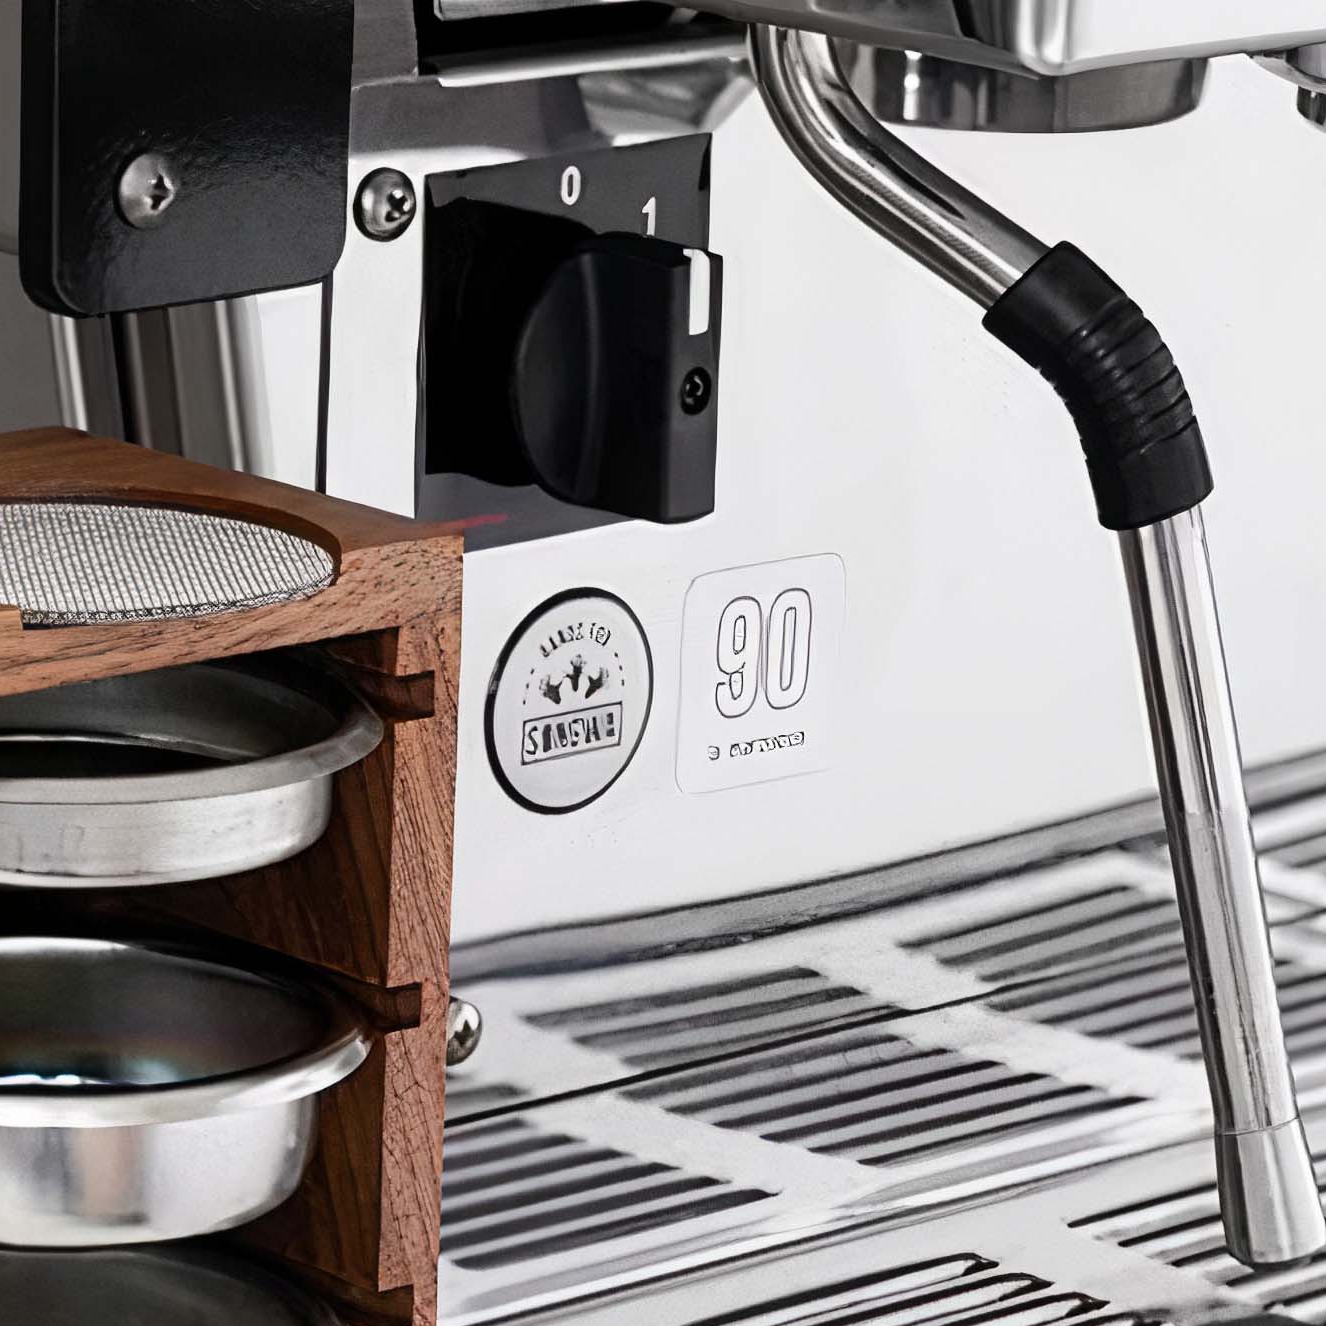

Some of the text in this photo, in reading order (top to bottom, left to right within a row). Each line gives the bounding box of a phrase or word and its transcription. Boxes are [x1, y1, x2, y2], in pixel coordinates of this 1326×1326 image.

[560, 165, 582, 206] 0
[641, 196, 657, 238] 1
[716, 588, 812, 719] 90
